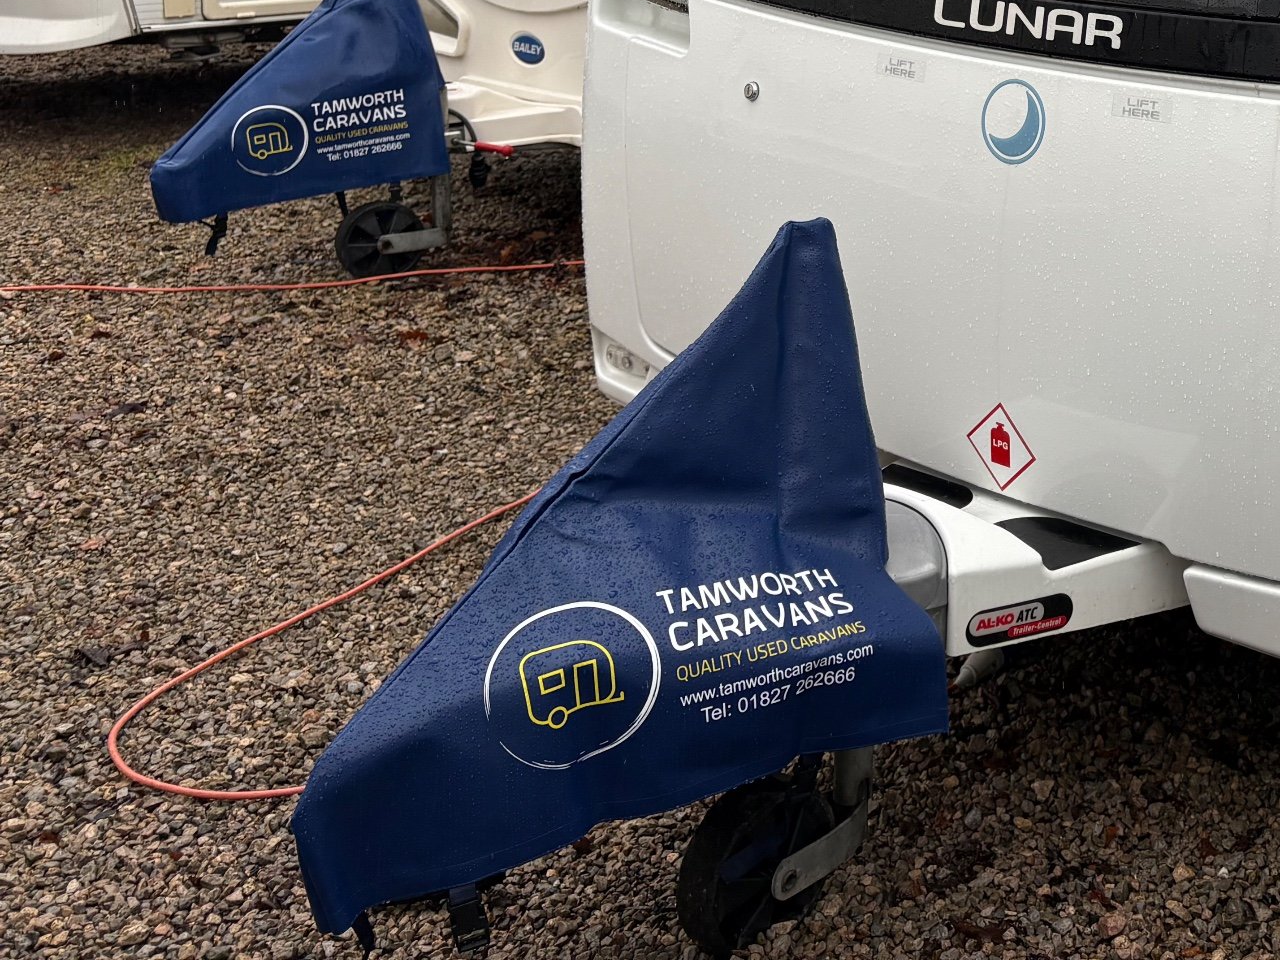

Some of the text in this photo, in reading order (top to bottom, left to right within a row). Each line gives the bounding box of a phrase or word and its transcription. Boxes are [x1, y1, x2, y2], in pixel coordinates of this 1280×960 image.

[513, 41, 542, 55] BAILEY
[885, 66, 916, 78] HERE
[889, 58, 915, 69] LIFT
[311, 89, 404, 116] TAMWORTH
[1127, 98, 1158, 109] LIFT
[313, 104, 406, 132] CARAVANS
[1122, 107, 1160, 120] HERE
[315, 121, 409, 144] QUALITY USED CARAVANS
[317, 132, 411, 154] www.tamworthcaravans.com
[327, 152, 342, 162] Tel:
[343, 146, 369, 159] 01827
[992, 439, 1008, 450] LPG
[656, 568, 838, 615] TAMWORTH
[668, 592, 854, 652] CARAVANS
[1016, 606, 1038, 623] ATC
[1013, 617, 1062, 636] Trailer-Control
[676, 620, 866, 682] QUALITY USED CARAVANS
[679, 643, 874, 707] www.tamworthcaravans.com
[701, 666, 856, 723] Tel: 01827 262666
